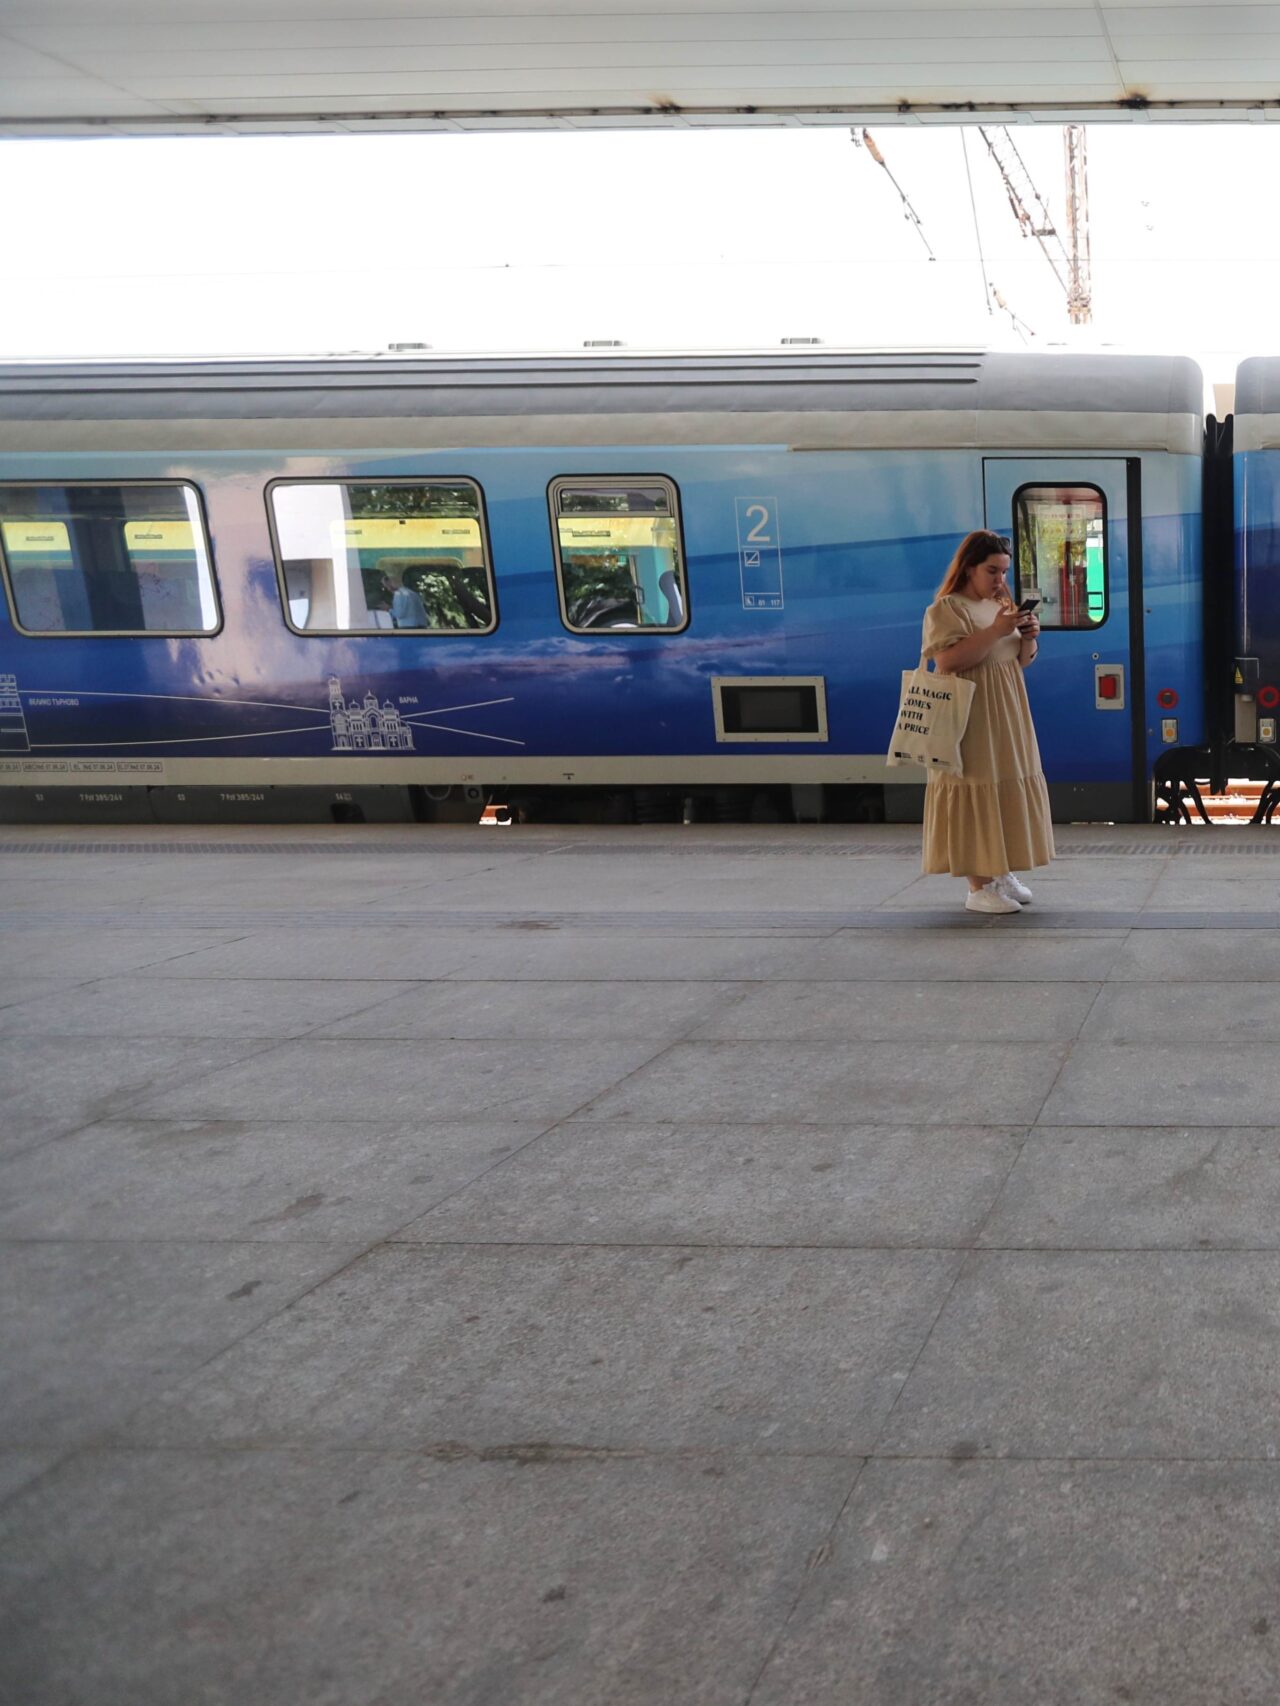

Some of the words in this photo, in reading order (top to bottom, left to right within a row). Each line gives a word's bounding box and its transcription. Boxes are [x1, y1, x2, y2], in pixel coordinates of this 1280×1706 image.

[745, 504, 771, 542] 2
[908, 686, 921, 696] LL
[922, 688, 952, 701] MAGIC
[904, 723, 930, 735] PRICE
